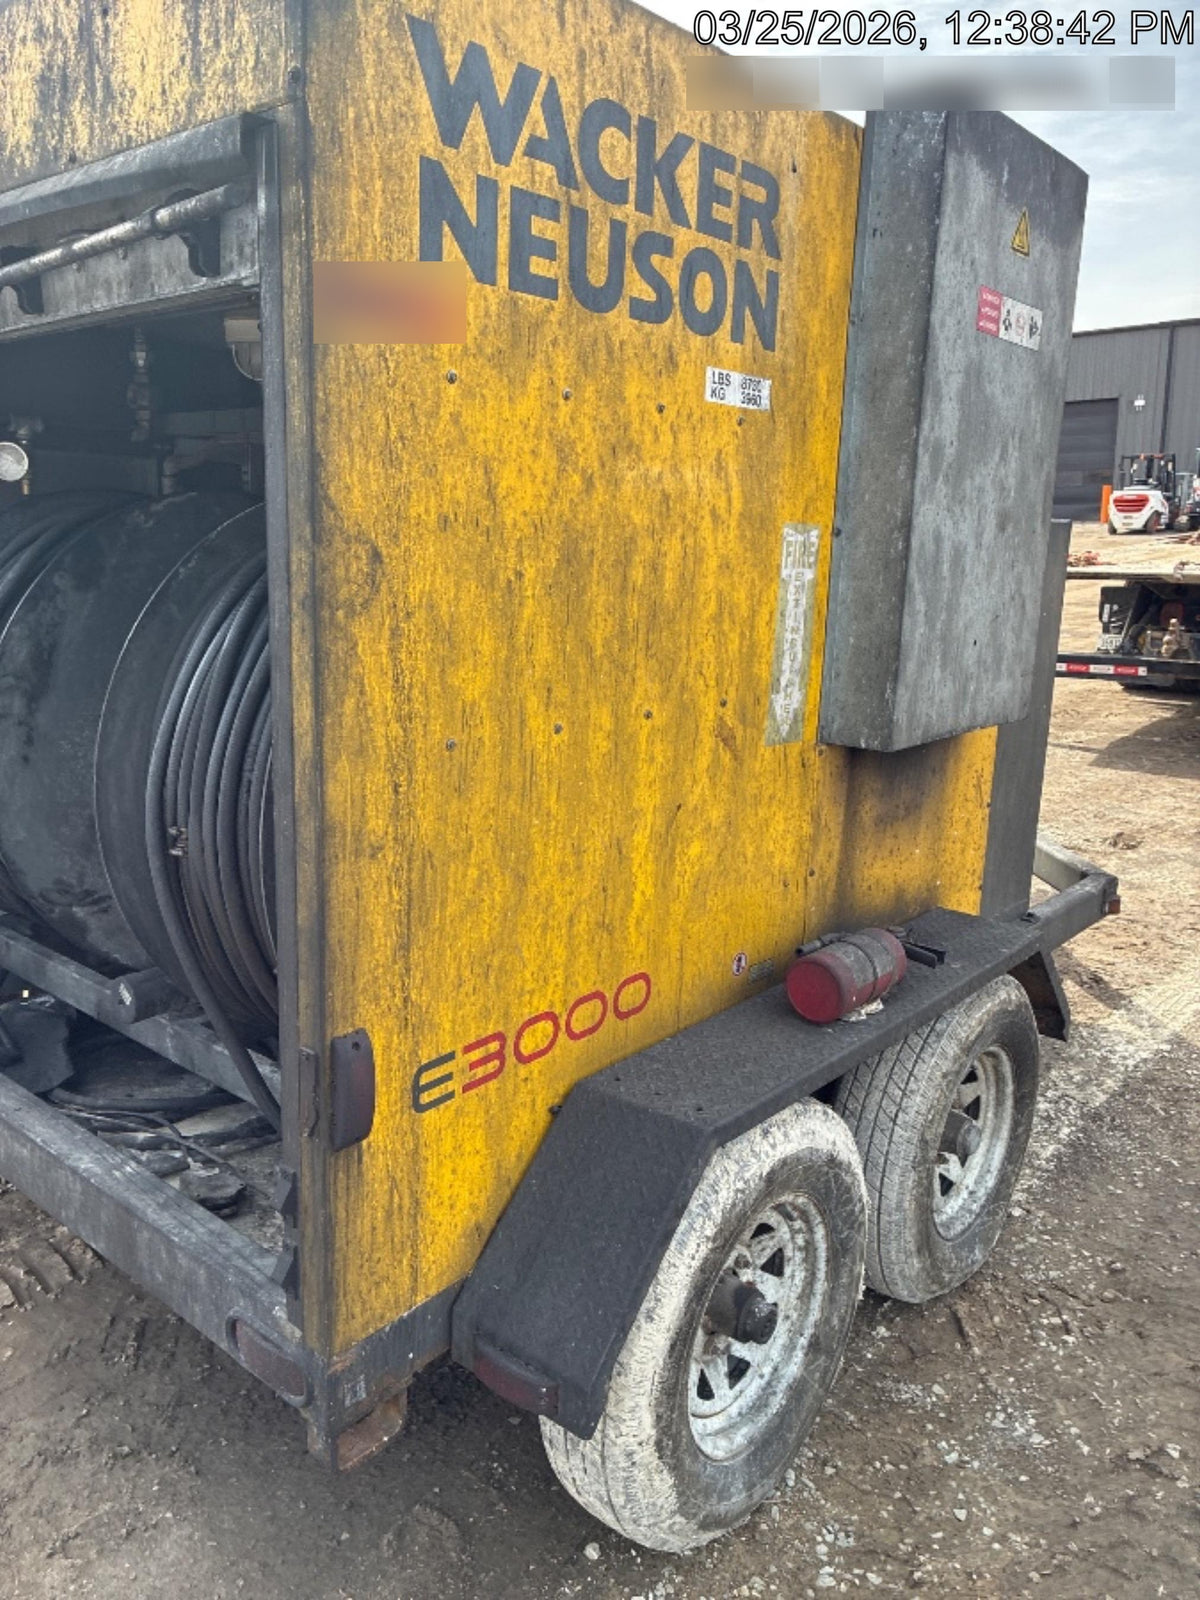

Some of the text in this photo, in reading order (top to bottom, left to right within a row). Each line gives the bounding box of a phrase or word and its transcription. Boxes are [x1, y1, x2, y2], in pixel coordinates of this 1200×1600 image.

[406, 15, 781, 259] WACKER
[418, 155, 780, 352] NEUSON
[710, 386, 727, 401] KG
[712, 371, 731, 386] LBS
[411, 971, 652, 1114] E3000
